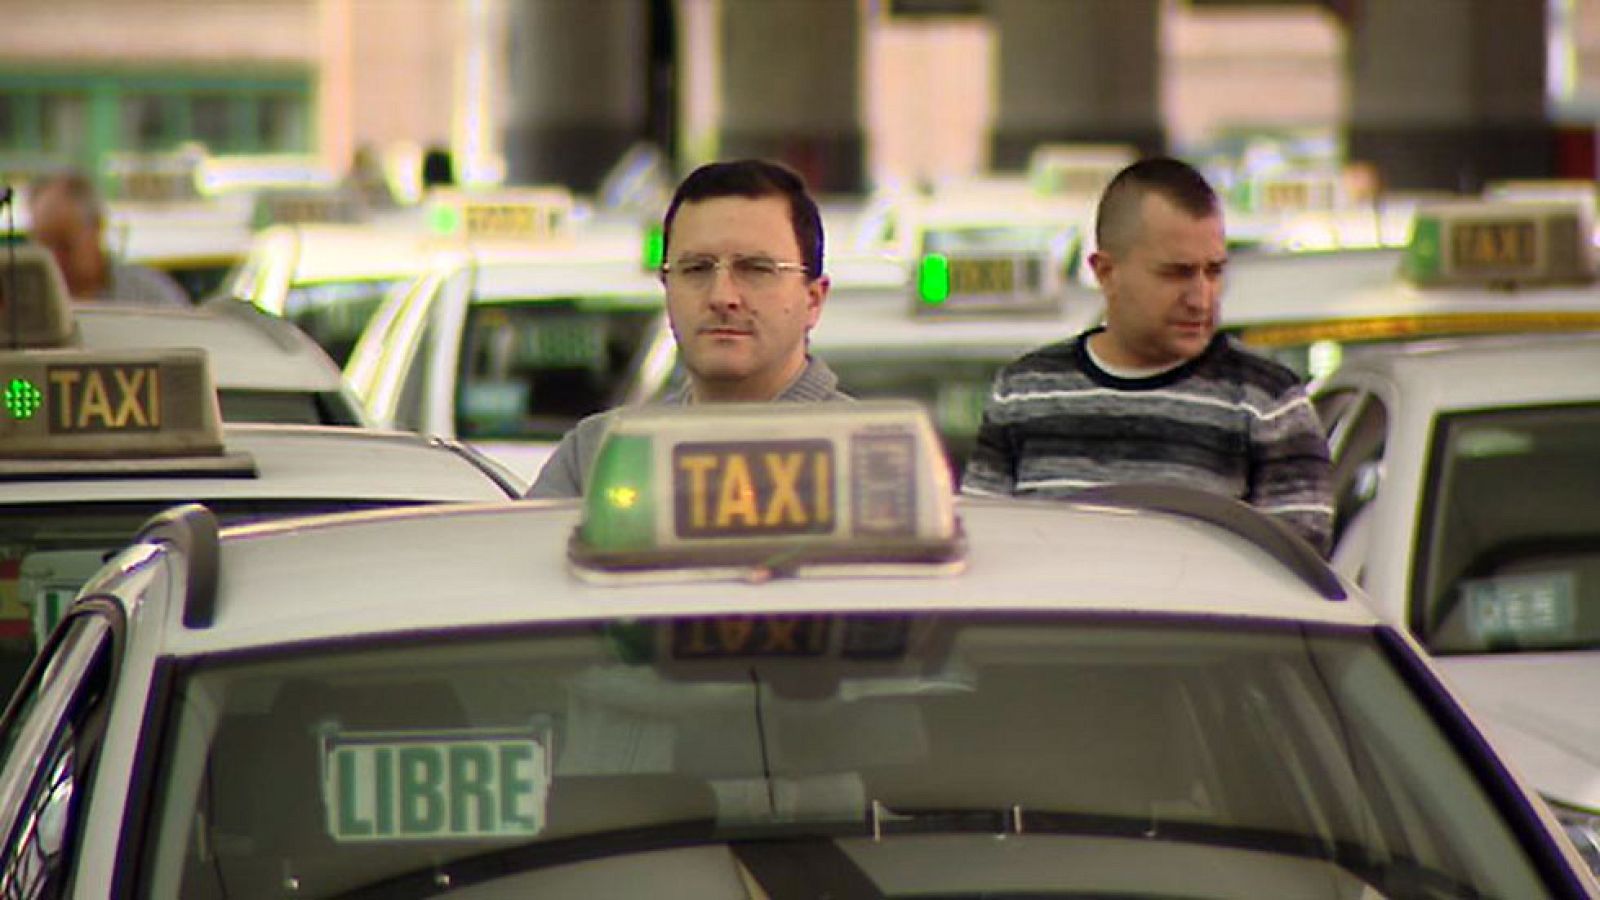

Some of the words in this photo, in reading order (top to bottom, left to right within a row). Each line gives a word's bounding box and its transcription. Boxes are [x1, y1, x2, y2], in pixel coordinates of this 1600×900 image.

[51, 367, 160, 428] TAXI
[680, 451, 830, 527] TAXI
[337, 744, 536, 835] LIBRE
